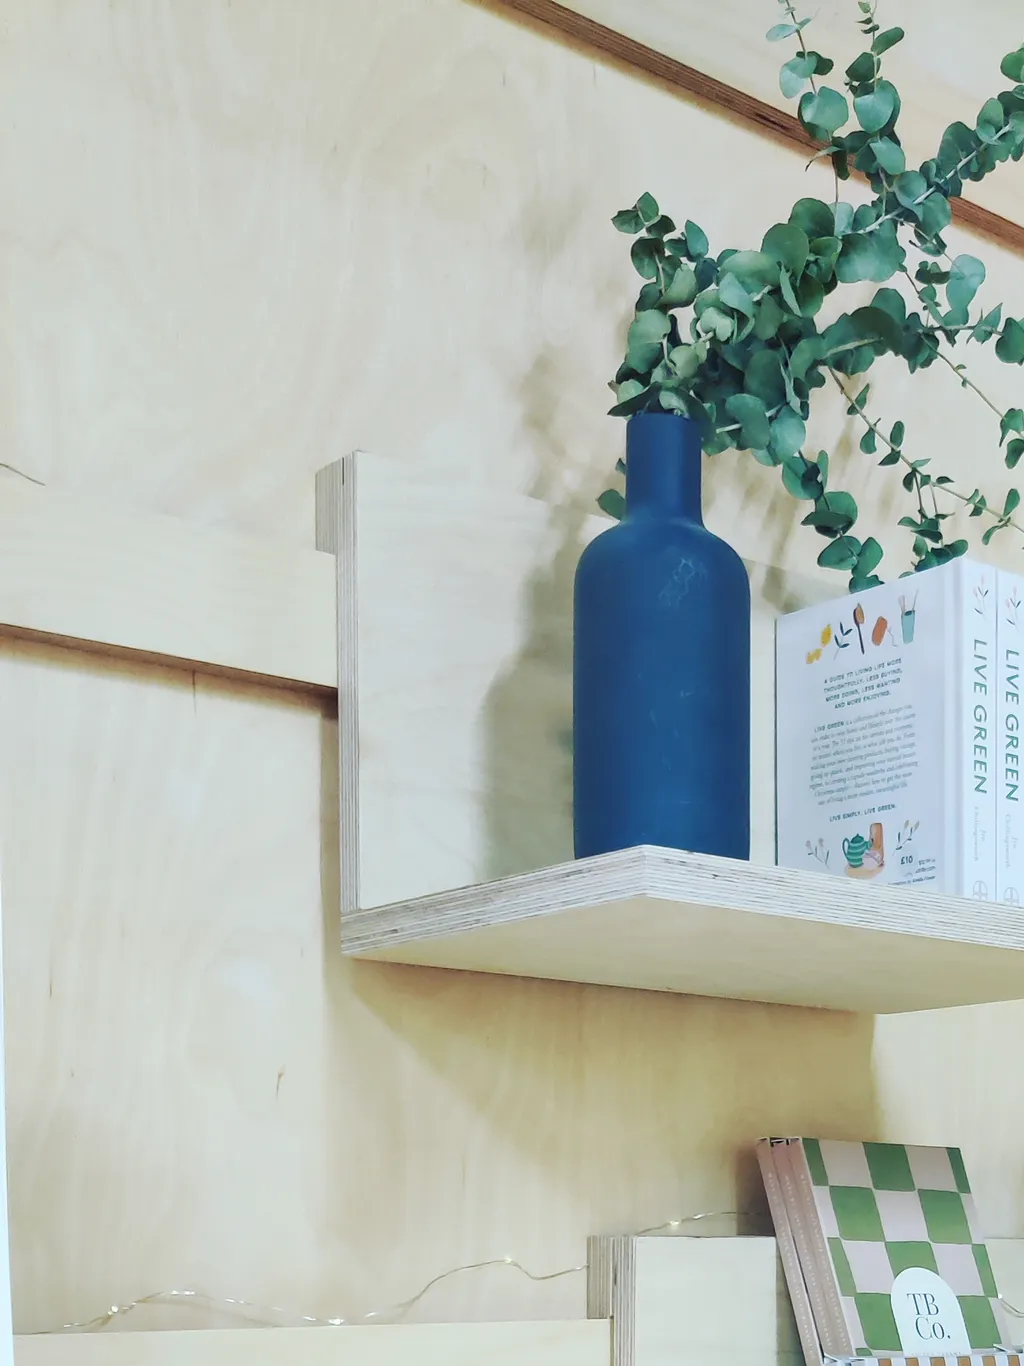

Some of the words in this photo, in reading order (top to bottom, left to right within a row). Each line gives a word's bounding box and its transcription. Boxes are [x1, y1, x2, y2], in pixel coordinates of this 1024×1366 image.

[973, 639, 988, 696] LIVE
[1005, 649, 1020, 705] LIVE
[973, 704, 988, 794] GREEN
[1005, 713, 1019, 801] GREEN
[901, 856, 913, 865] £10
[906, 1293, 939, 1316] TB
[915, 1316, 951, 1340] Co.
